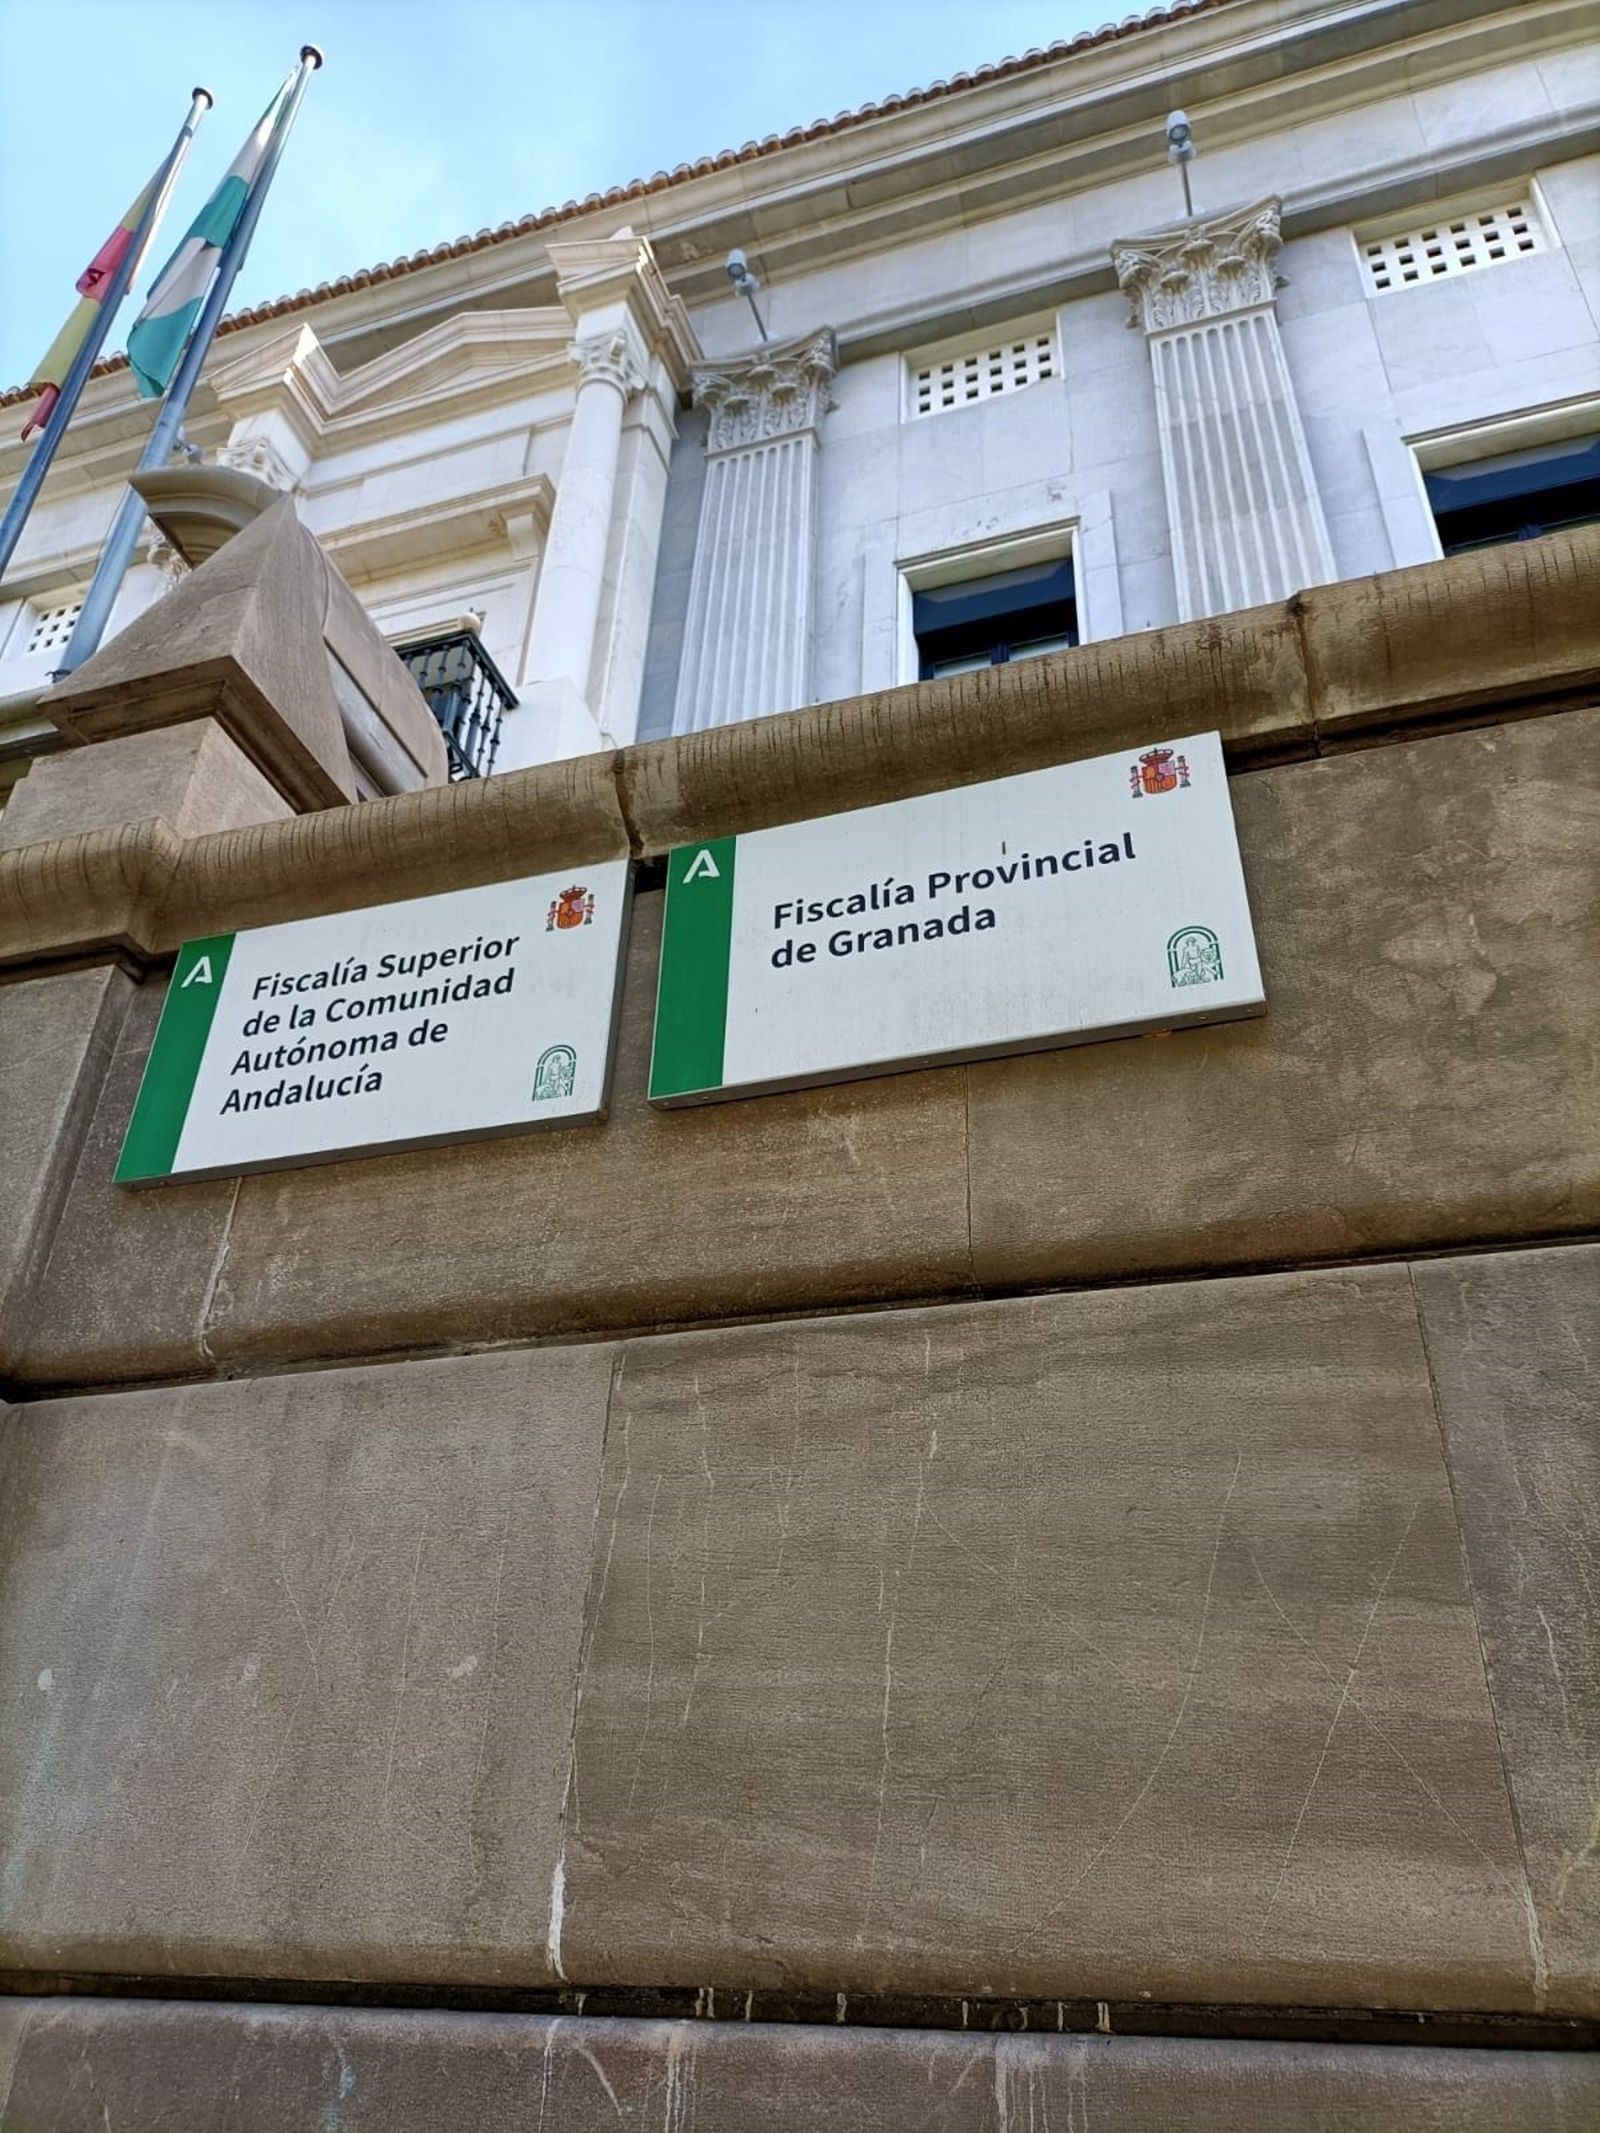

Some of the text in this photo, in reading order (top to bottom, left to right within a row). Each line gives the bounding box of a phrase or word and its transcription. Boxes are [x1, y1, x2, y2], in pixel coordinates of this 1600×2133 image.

[774, 831, 1136, 930] Fiscalía Provincial
[252, 936, 521, 1001] Fiscalía Superior
[771, 904, 996, 969] de Granada
[242, 967, 515, 1037] de la Comunidad
[230, 1018, 449, 1076] Autónoma de
[219, 1063, 383, 1115] Andalucía
